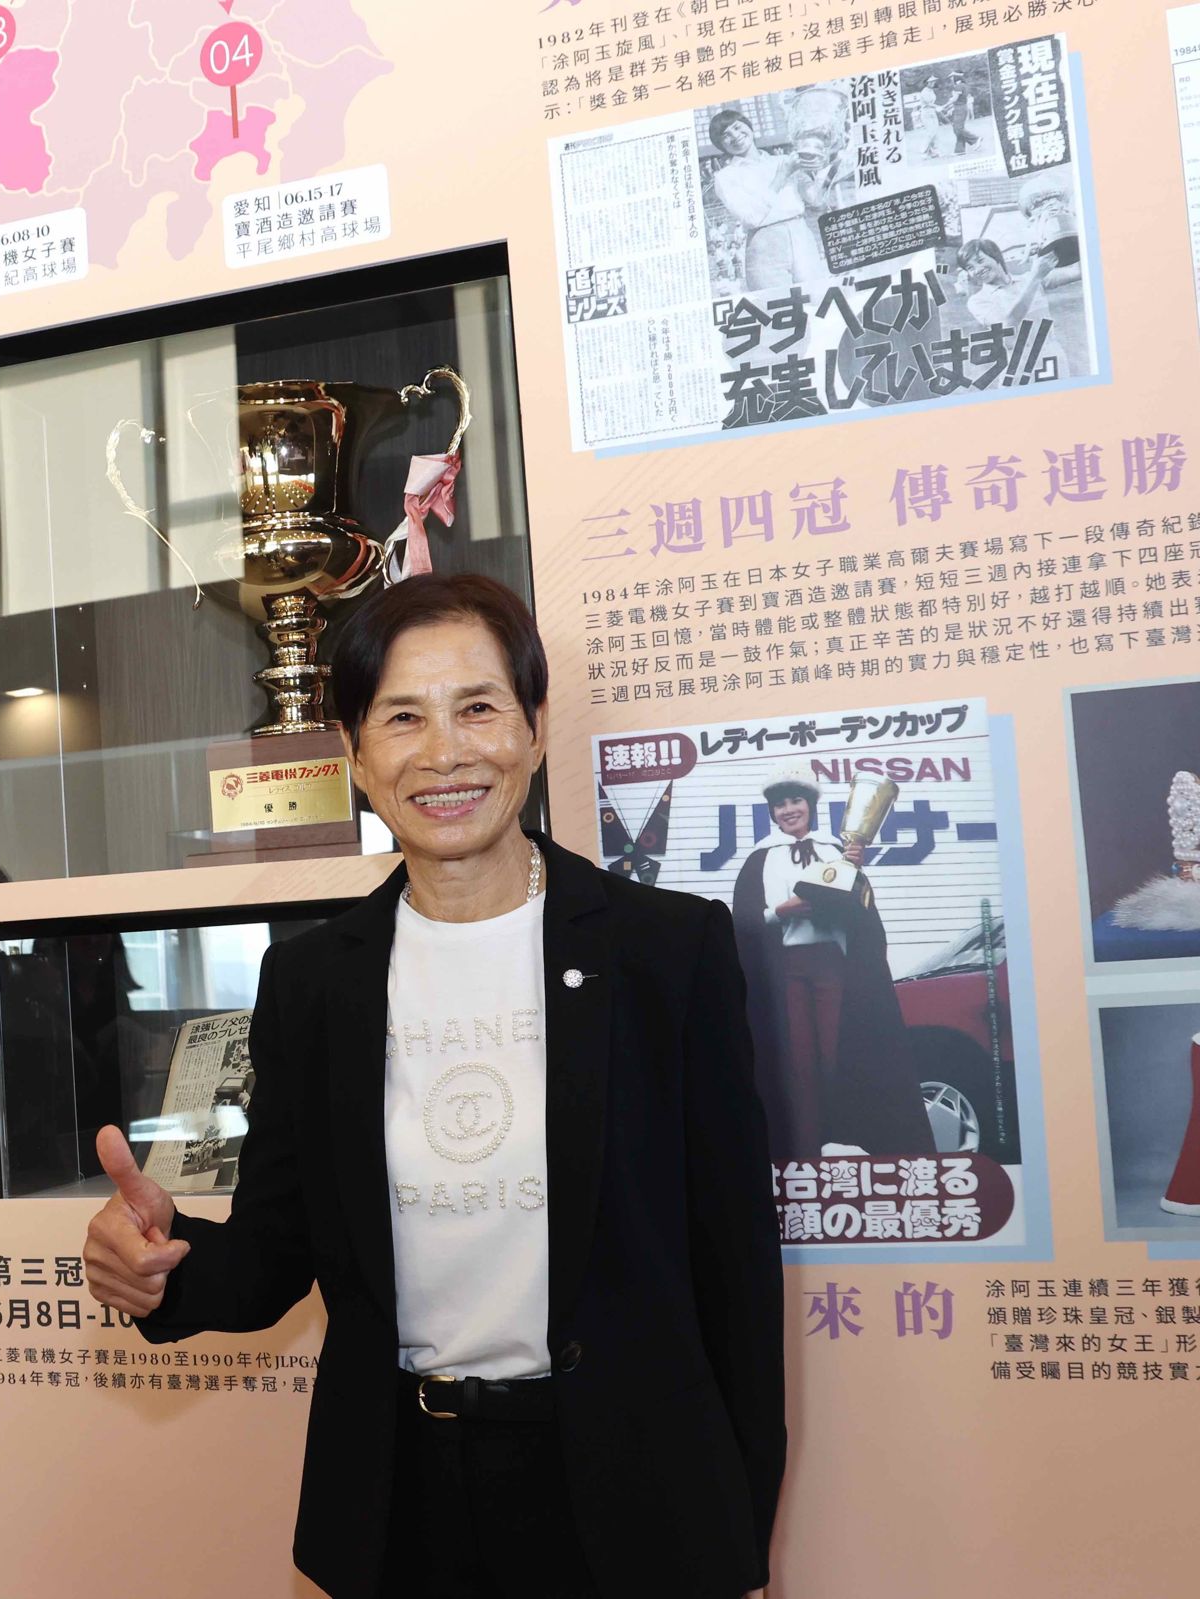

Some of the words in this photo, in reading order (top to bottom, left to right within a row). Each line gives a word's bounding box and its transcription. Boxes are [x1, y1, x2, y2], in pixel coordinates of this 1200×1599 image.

[209, 34, 254, 75] 04
[876, 69, 904, 164] 吹き荒れる
[998, 47, 1030, 172] 賞金ランク第1位
[1018, 40, 1067, 166] 現在5勝
[850, 74, 883, 189] 涂阿玉旋風
[233, 195, 271, 218] 愛知
[234, 198, 358, 238] 寶酒造邀請賽
[235, 216, 382, 260] 平尾鄉村高球場
[566, 296, 628, 323] シリーズ
[580, 476, 852, 561] 三週四冠
[888, 432, 1188, 526] 傳奇連勝
[585, 570, 1200, 656] 涂阿玉回憶，當時體能或整體狀態都特別好，越打越順。她表
[589, 625, 1200, 705] 三週四冠展現涂阿玉巔峰時期的實力與穩定性，也寫下臺灣
[699, 705, 970, 757] レディーボーデンカップ
[604, 738, 681, 771] 速報!!
[810, 757, 972, 783] NISSAN
[394, 1175, 545, 1216] PARIS
[776, 1198, 982, 1240] 顔の最優秀
[990, 1360, 1200, 1382] 備受矚目的競技實
